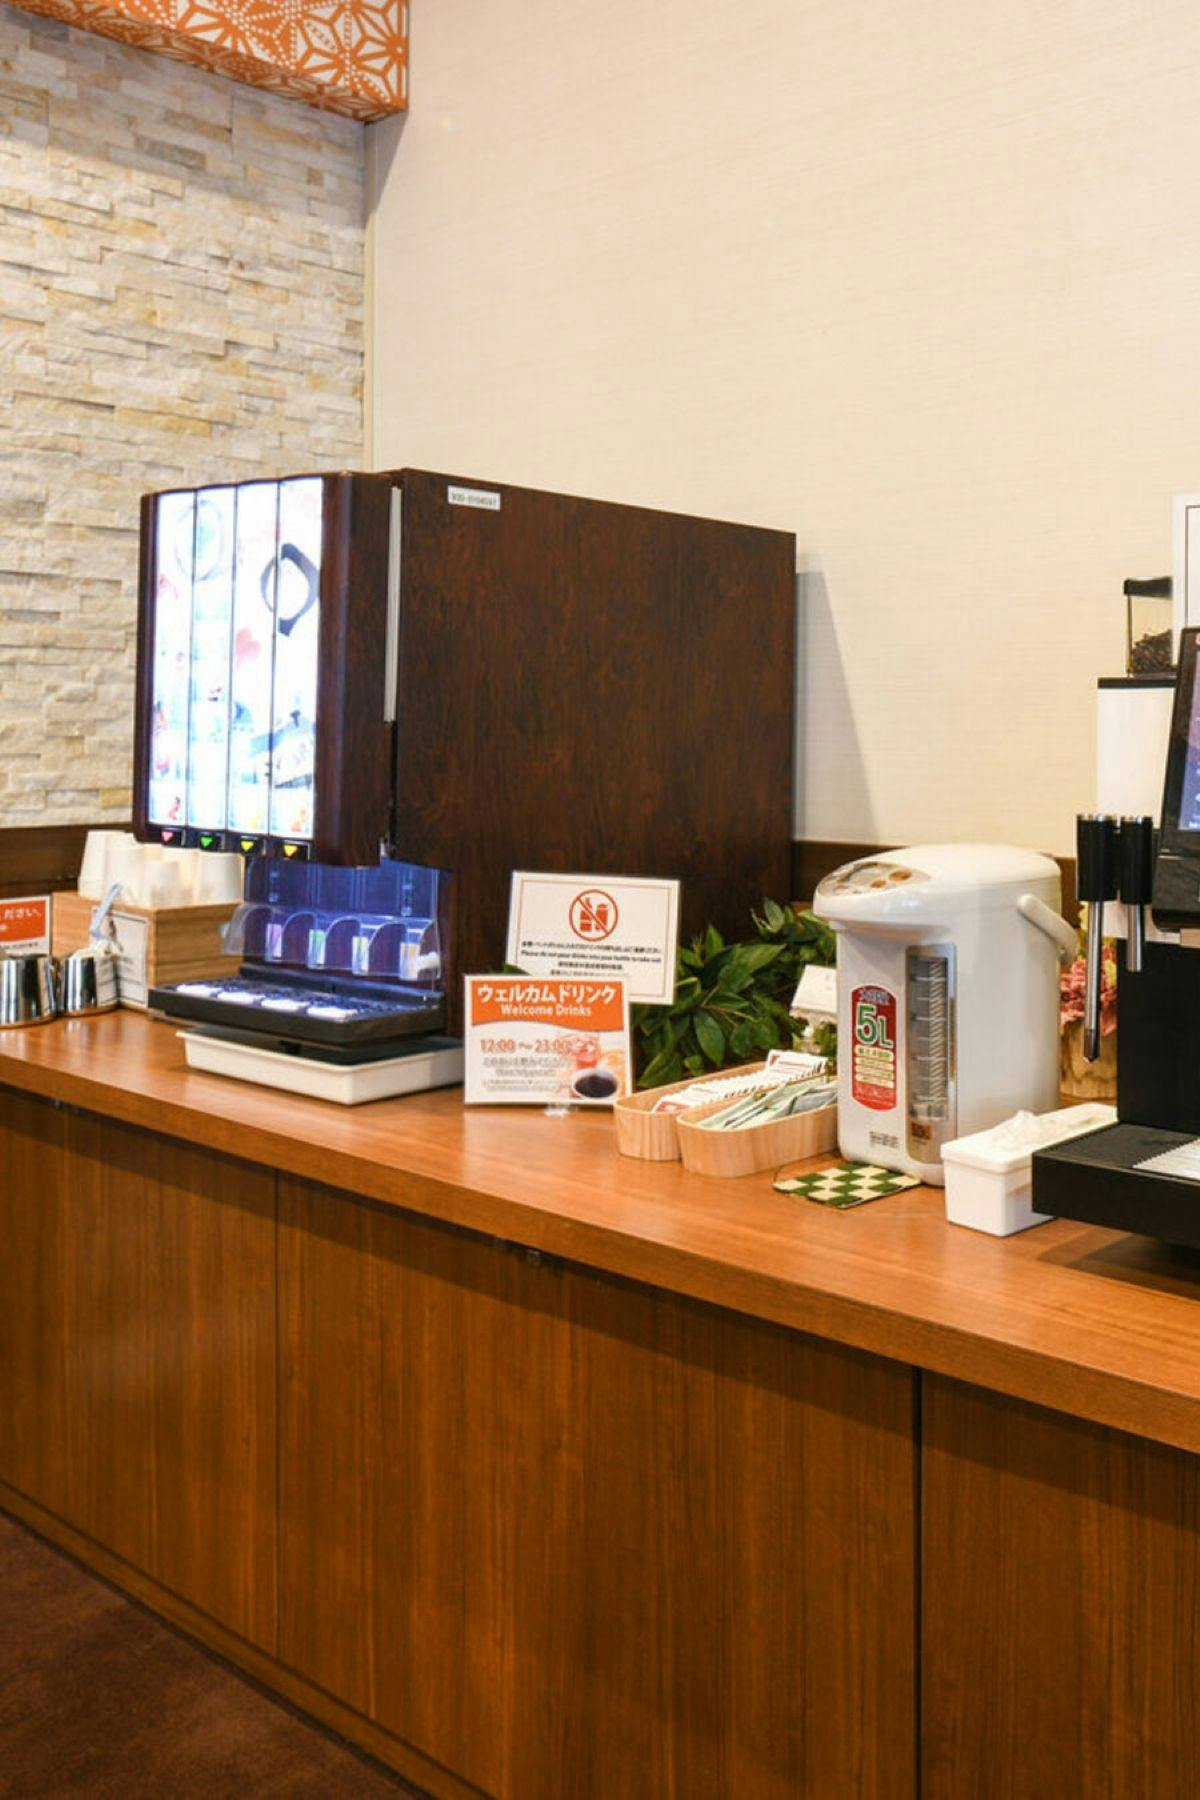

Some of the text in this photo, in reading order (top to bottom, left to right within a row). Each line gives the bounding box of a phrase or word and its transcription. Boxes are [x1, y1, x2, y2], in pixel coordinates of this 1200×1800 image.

[477, 984, 617, 1005] ウェルカムドリンク
[500, 1003, 592, 1017] Welcome Drinks
